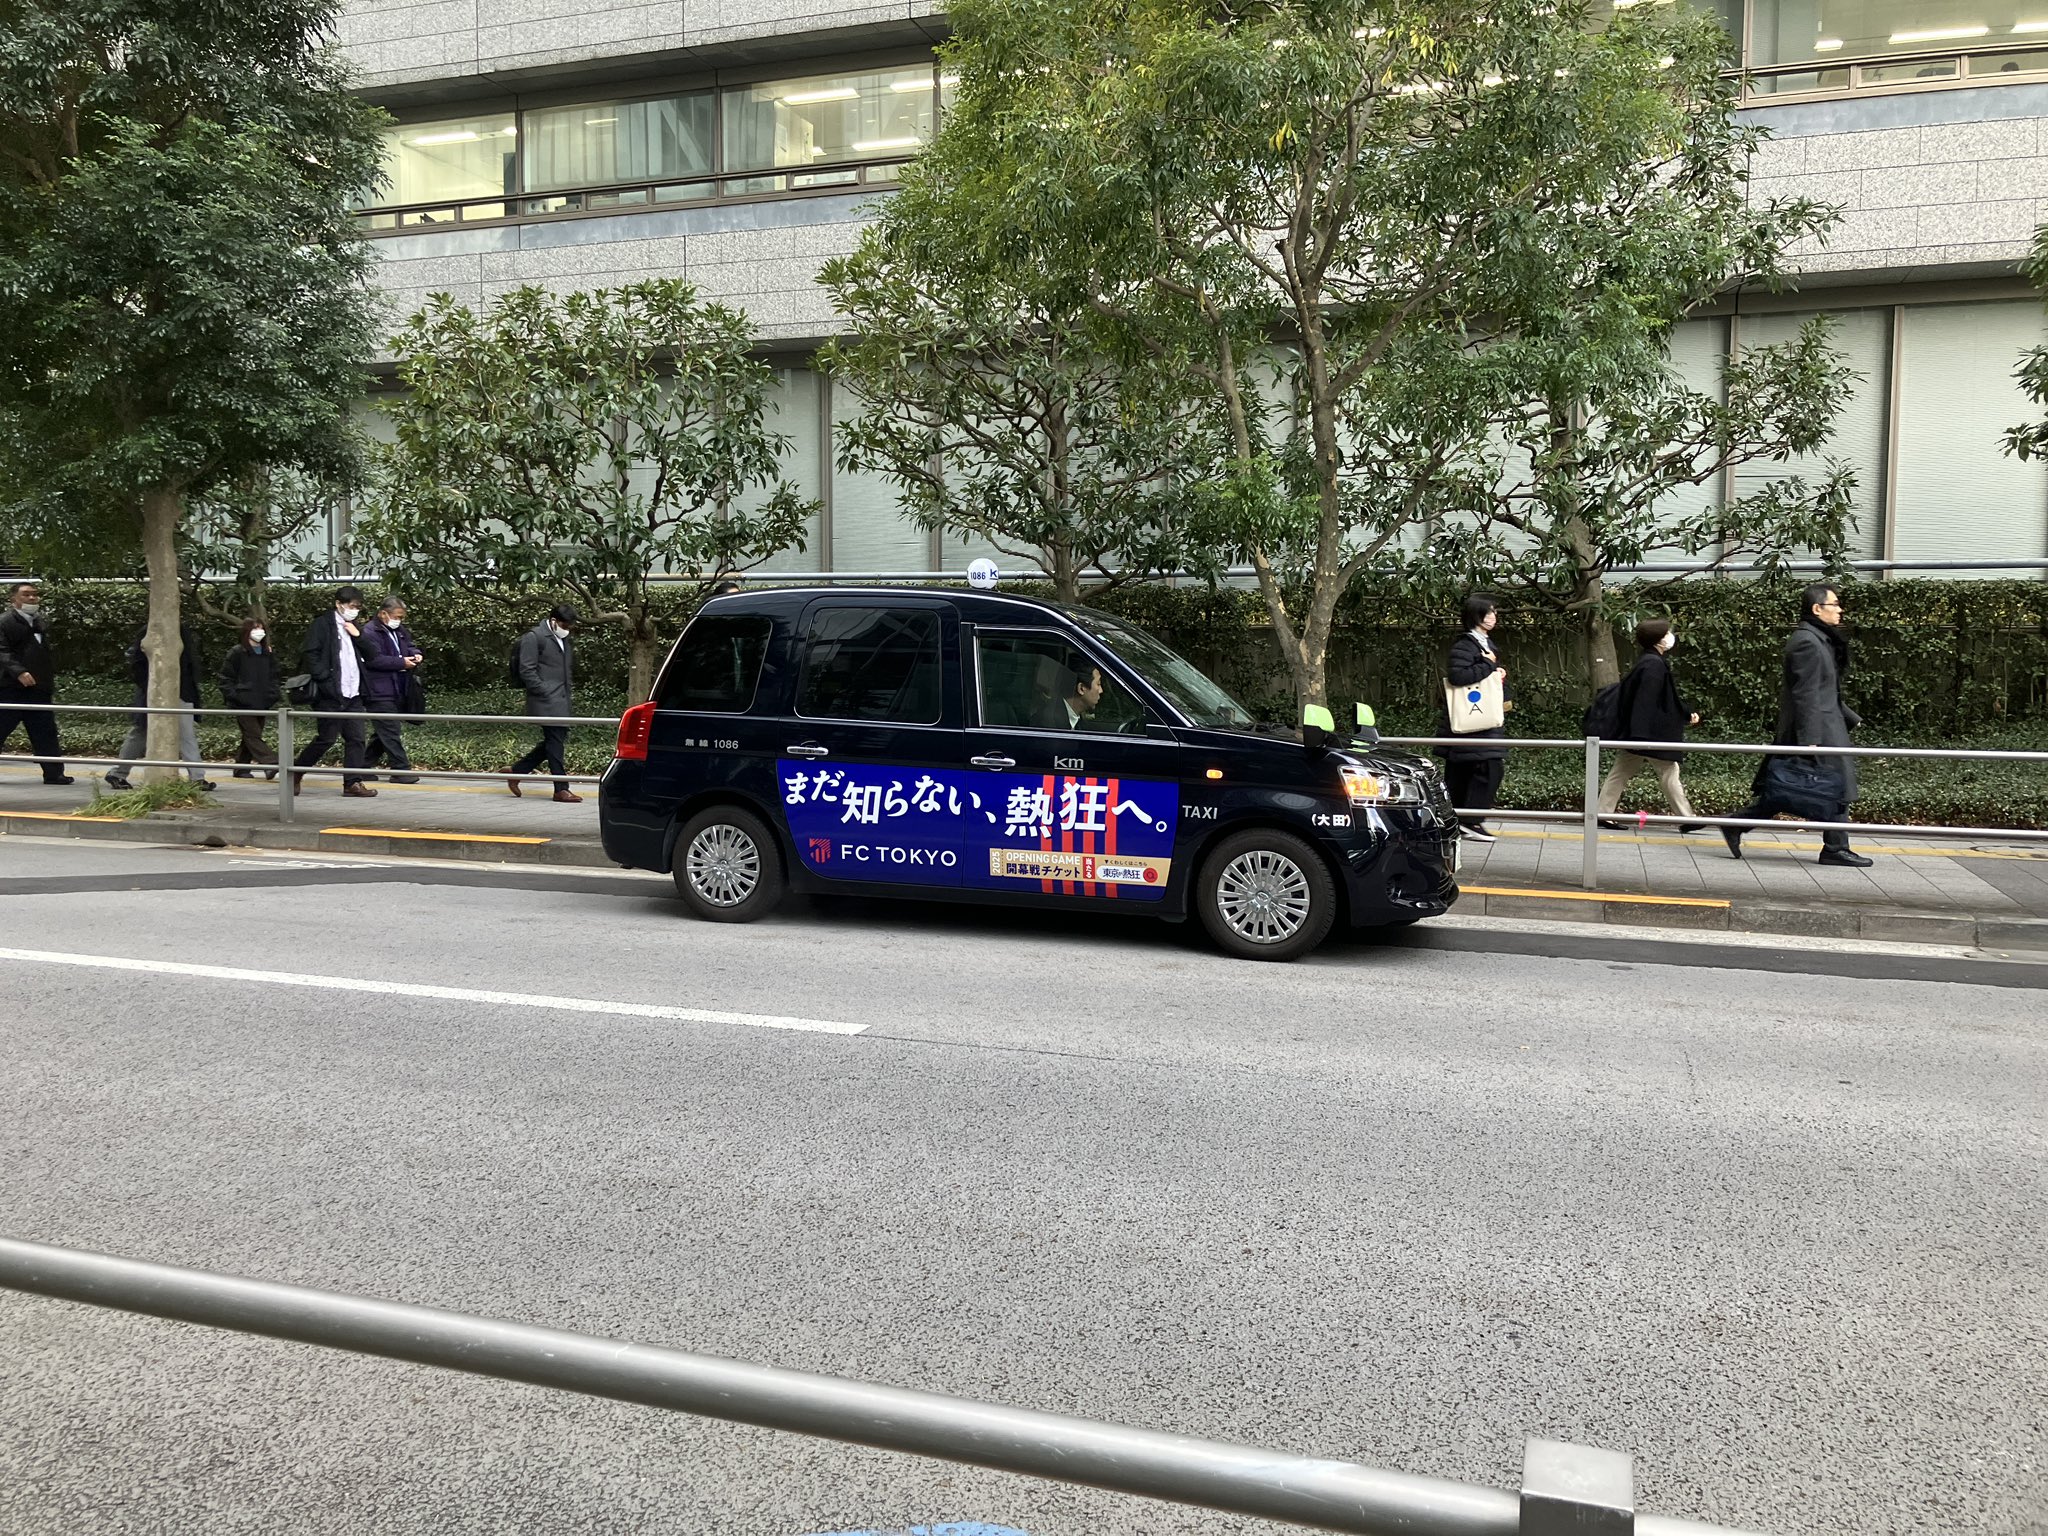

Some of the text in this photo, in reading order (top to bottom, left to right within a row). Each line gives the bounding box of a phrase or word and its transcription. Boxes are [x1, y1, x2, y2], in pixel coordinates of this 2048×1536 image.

[970, 572, 986, 580] 1086
[714, 739, 739, 749] 1086
[1054, 756, 1084, 769] km
[1182, 805, 1218, 820] TAXI
[1311, 813, 1351, 827] (大田)
[841, 844, 957, 867] FC TOKYO
[992, 851, 1000, 874] 2025
[1006, 852, 1081, 865] OPENING GAME
[1006, 863, 1080, 878] 開幕戦チケット
[1085, 857, 1093, 878] 当たる
